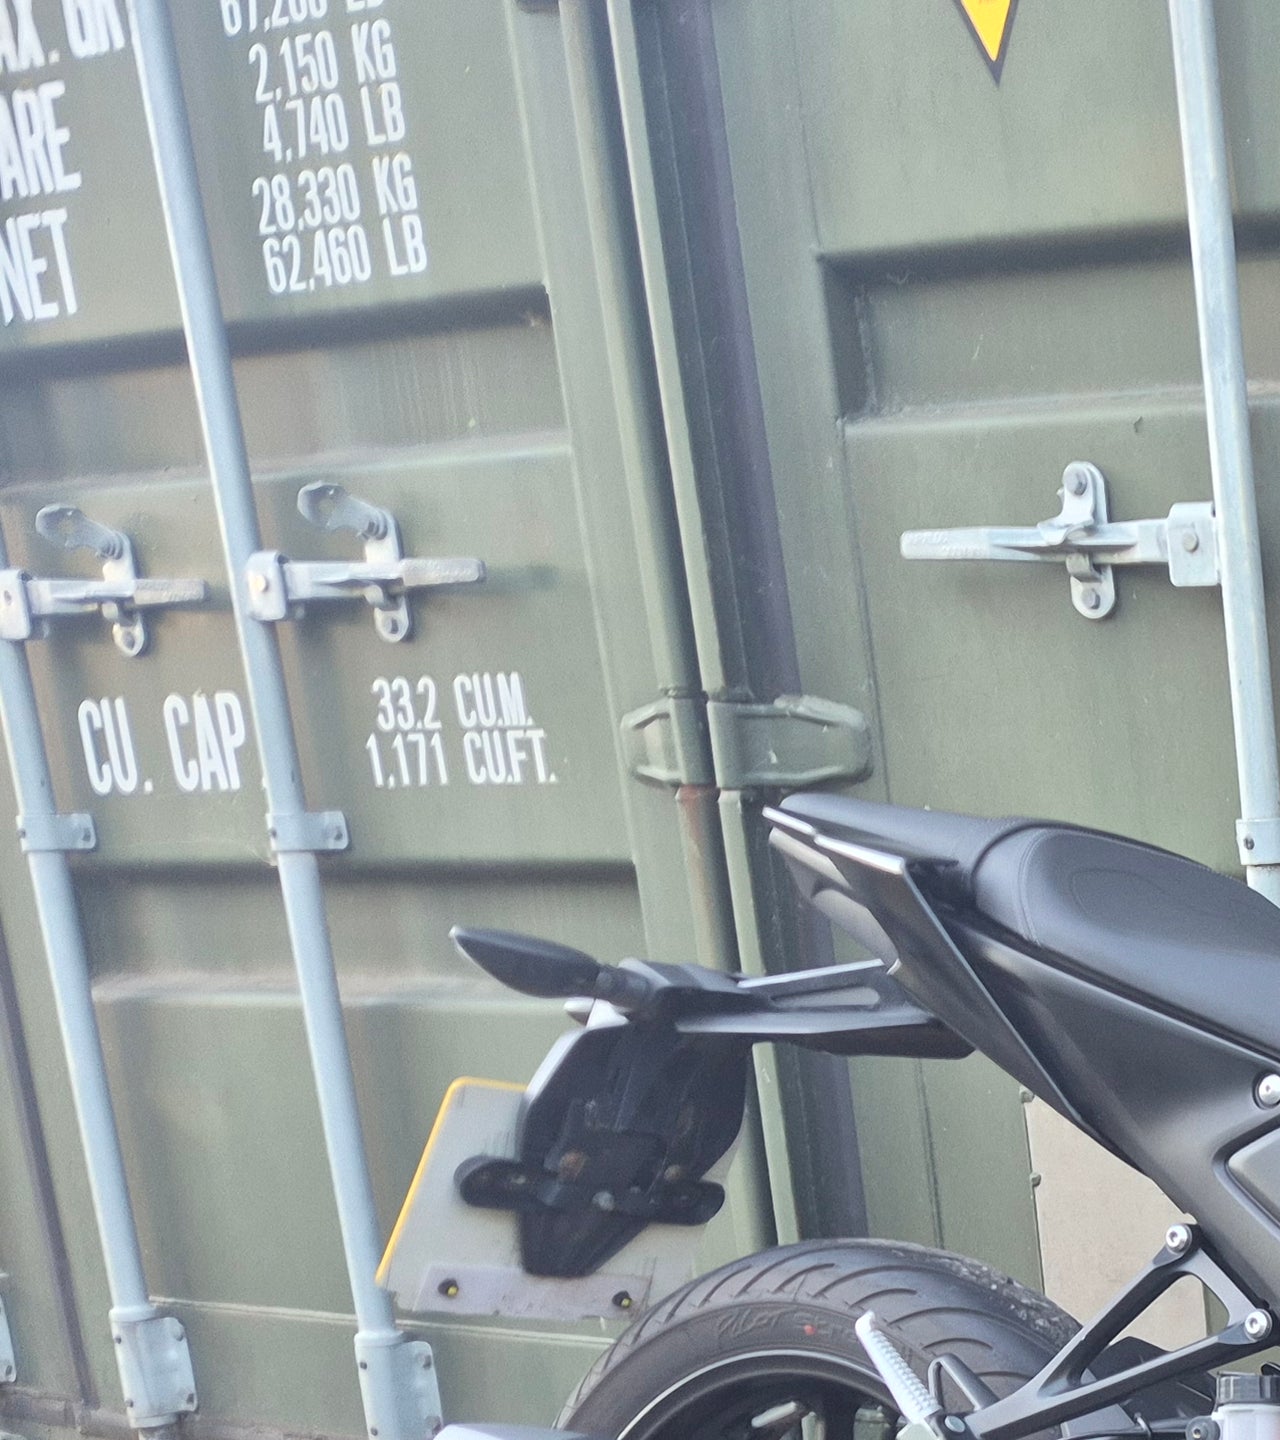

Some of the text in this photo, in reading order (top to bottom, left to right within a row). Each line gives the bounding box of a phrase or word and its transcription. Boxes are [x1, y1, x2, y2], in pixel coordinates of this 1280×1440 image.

[248, 19, 397, 104] 2,150 KG
[264, 82, 406, 163] 4,740 LB
[252, 152, 418, 236] 28,330 KG
[0, 208, 78, 326] NET
[262, 213, 428, 294] 62,460 LB
[372, 671, 534, 732] 33.2 CU.M.
[77, 696, 153, 795] CU.
[366, 728, 558, 790] 1,171 CU.FT.
